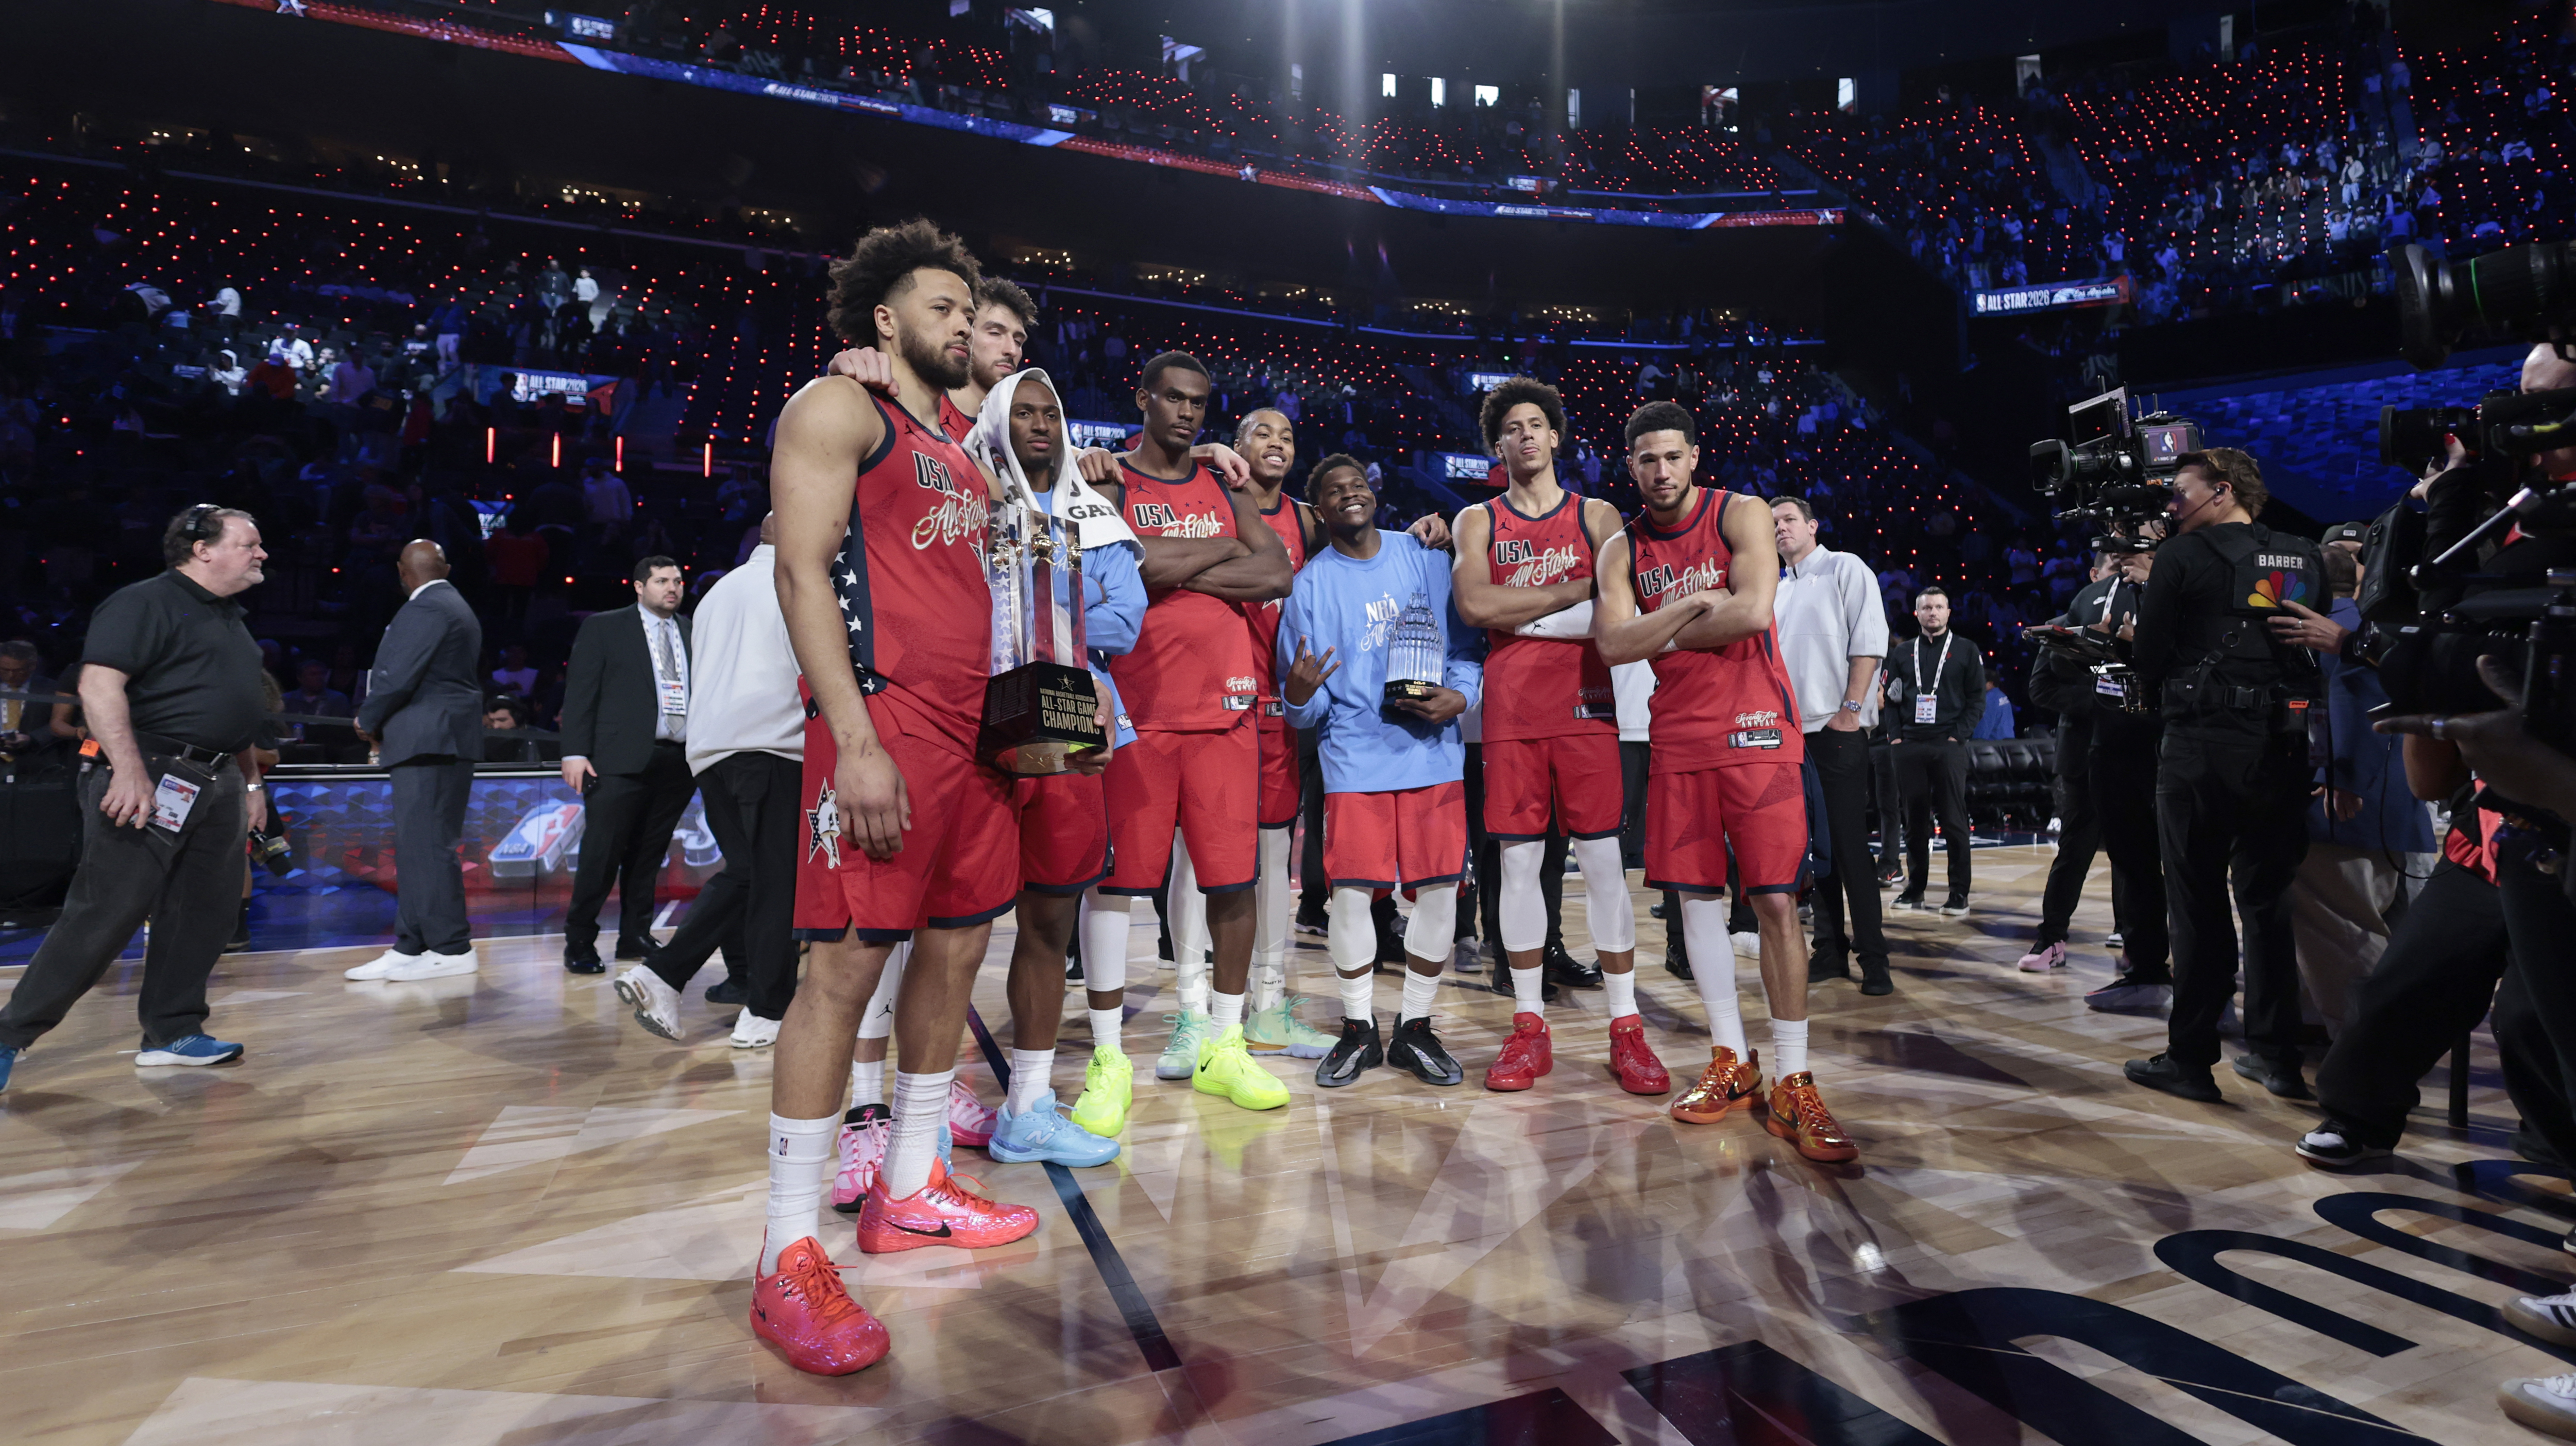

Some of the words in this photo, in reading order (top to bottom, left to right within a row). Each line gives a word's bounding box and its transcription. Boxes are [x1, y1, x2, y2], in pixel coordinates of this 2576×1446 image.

[1987, 295, 2002, 311] ALL
[2004, 292, 2027, 309] STAR
[2027, 289, 2050, 307] 2026
[529, 375, 544, 388] ALL
[545, 376, 567, 390] STAR
[1083, 424, 1094, 436] ALL
[1094, 426, 1111, 438] STAR
[1110, 427, 1126, 439] 2026
[1455, 457, 1465, 468] ALL
[1465, 458, 1478, 469] STAR
[912, 450, 957, 500] USA
[1133, 503, 1180, 529] USA
[1495, 539, 1535, 565] USA
[2259, 554, 2303, 569] BARBER
[1638, 563, 1676, 599] USA
[1365, 598, 1400, 623] NBA
[1041, 694, 1076, 713] ALL-STAR
[1076, 701, 1096, 717] GAME
